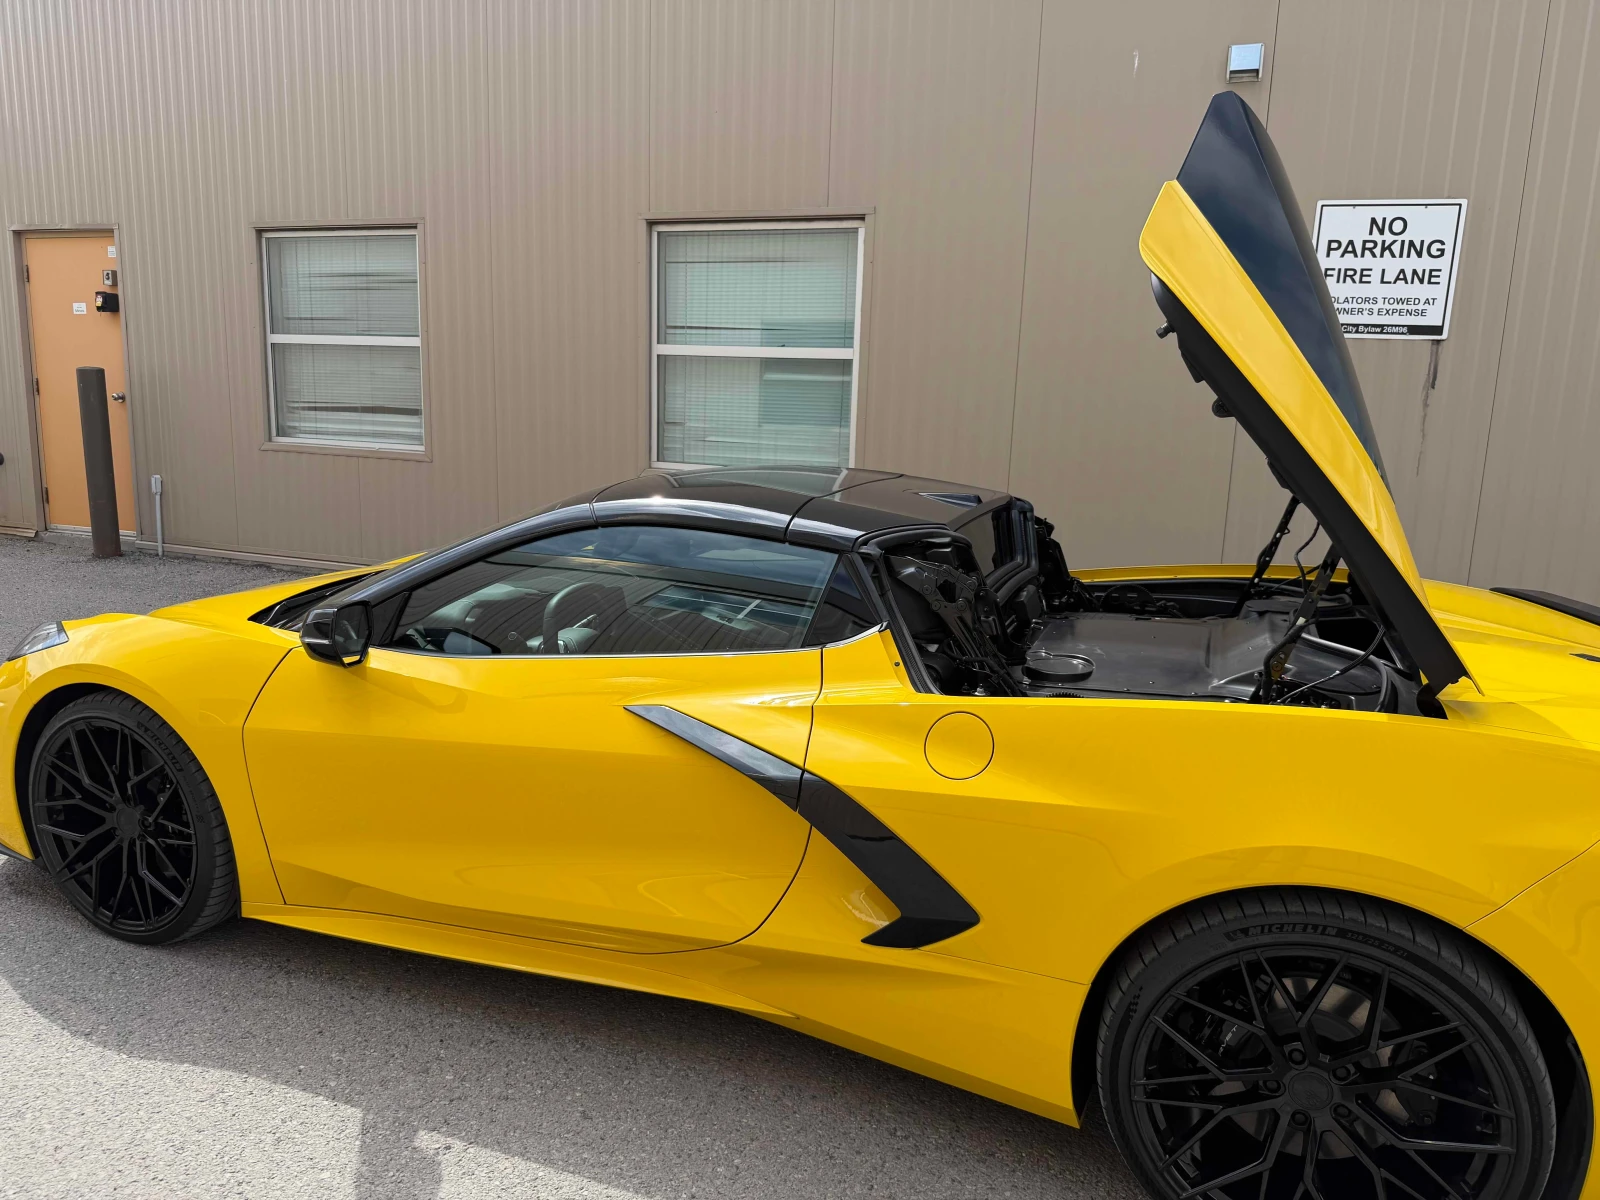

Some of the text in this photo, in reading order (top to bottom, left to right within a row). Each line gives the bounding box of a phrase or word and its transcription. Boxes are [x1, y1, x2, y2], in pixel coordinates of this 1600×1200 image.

[1368, 216, 1408, 236] NO
[1325, 239, 1446, 259] PARKING
[1323, 267, 1442, 285] FIRE LANE
[1331, 296, 1437, 306] OLATORS TOWED AT
[1334, 307, 1428, 317] WNER'S EXPENSE
[1341, 325, 1408, 334] City Bylaw 26M96
[1249, 923, 1338, 937] MICHELIN
